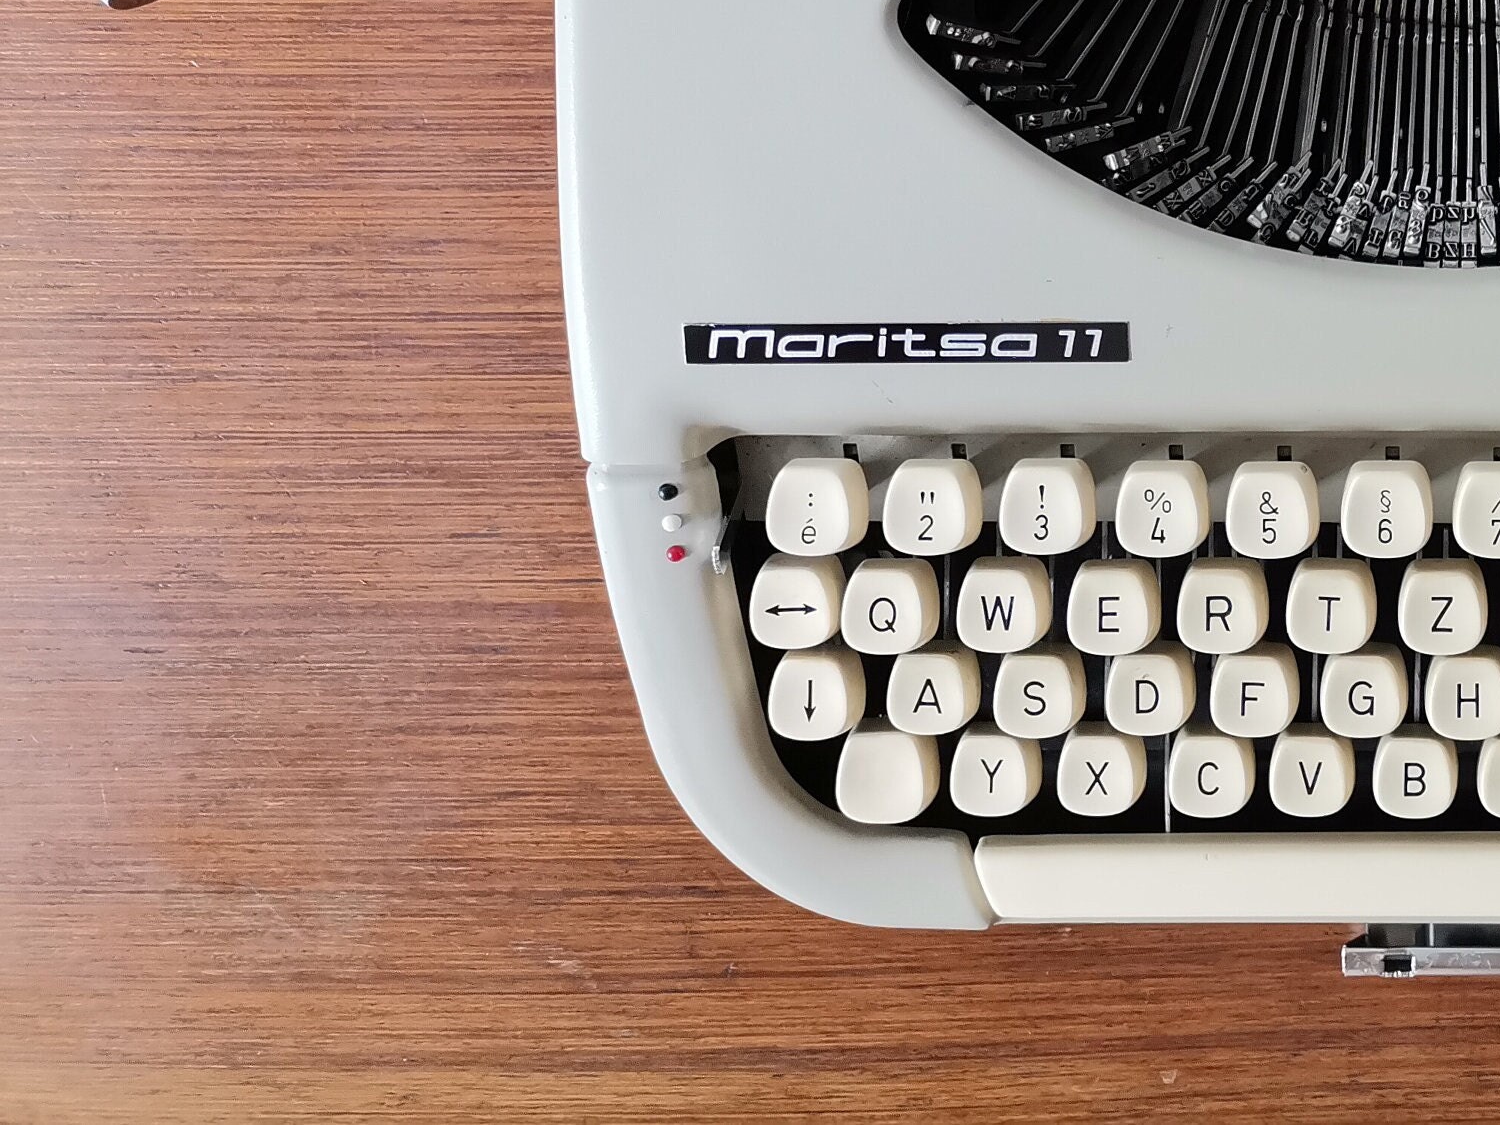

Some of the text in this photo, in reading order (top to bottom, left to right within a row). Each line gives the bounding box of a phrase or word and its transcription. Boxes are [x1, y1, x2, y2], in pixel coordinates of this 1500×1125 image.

[1059, 330, 1102, 357] 11
[1038, 484, 1045, 509] !
[1145, 490, 1171, 513] %
[1260, 492, 1278, 514] &
[1381, 490, 1391, 513] §
[802, 519, 816, 544] é
[918, 515, 933, 540] 2
[1034, 515, 1048, 540] 3
[1151, 518, 1165, 543] 4
[1263, 519, 1276, 544] 5
[1379, 519, 1392, 543] 6
[869, 598, 896, 633] Q
[981, 596, 1014, 630] W
[1099, 597, 1119, 632] E
[1206, 596, 1232, 631] R
[1319, 597, 1340, 631] T
[1432, 597, 1453, 632] Z
[913, 679, 941, 713] A
[1024, 681, 1046, 715] S
[1136, 680, 1159, 713] D
[1241, 682, 1264, 716] F
[1349, 681, 1374, 715] G
[1457, 684, 1479, 718] H
[981, 759, 1003, 793] Y
[1086, 762, 1108, 795] X
[1198, 762, 1219, 795] C
[1299, 762, 1322, 795] V
[1404, 763, 1425, 796] B
